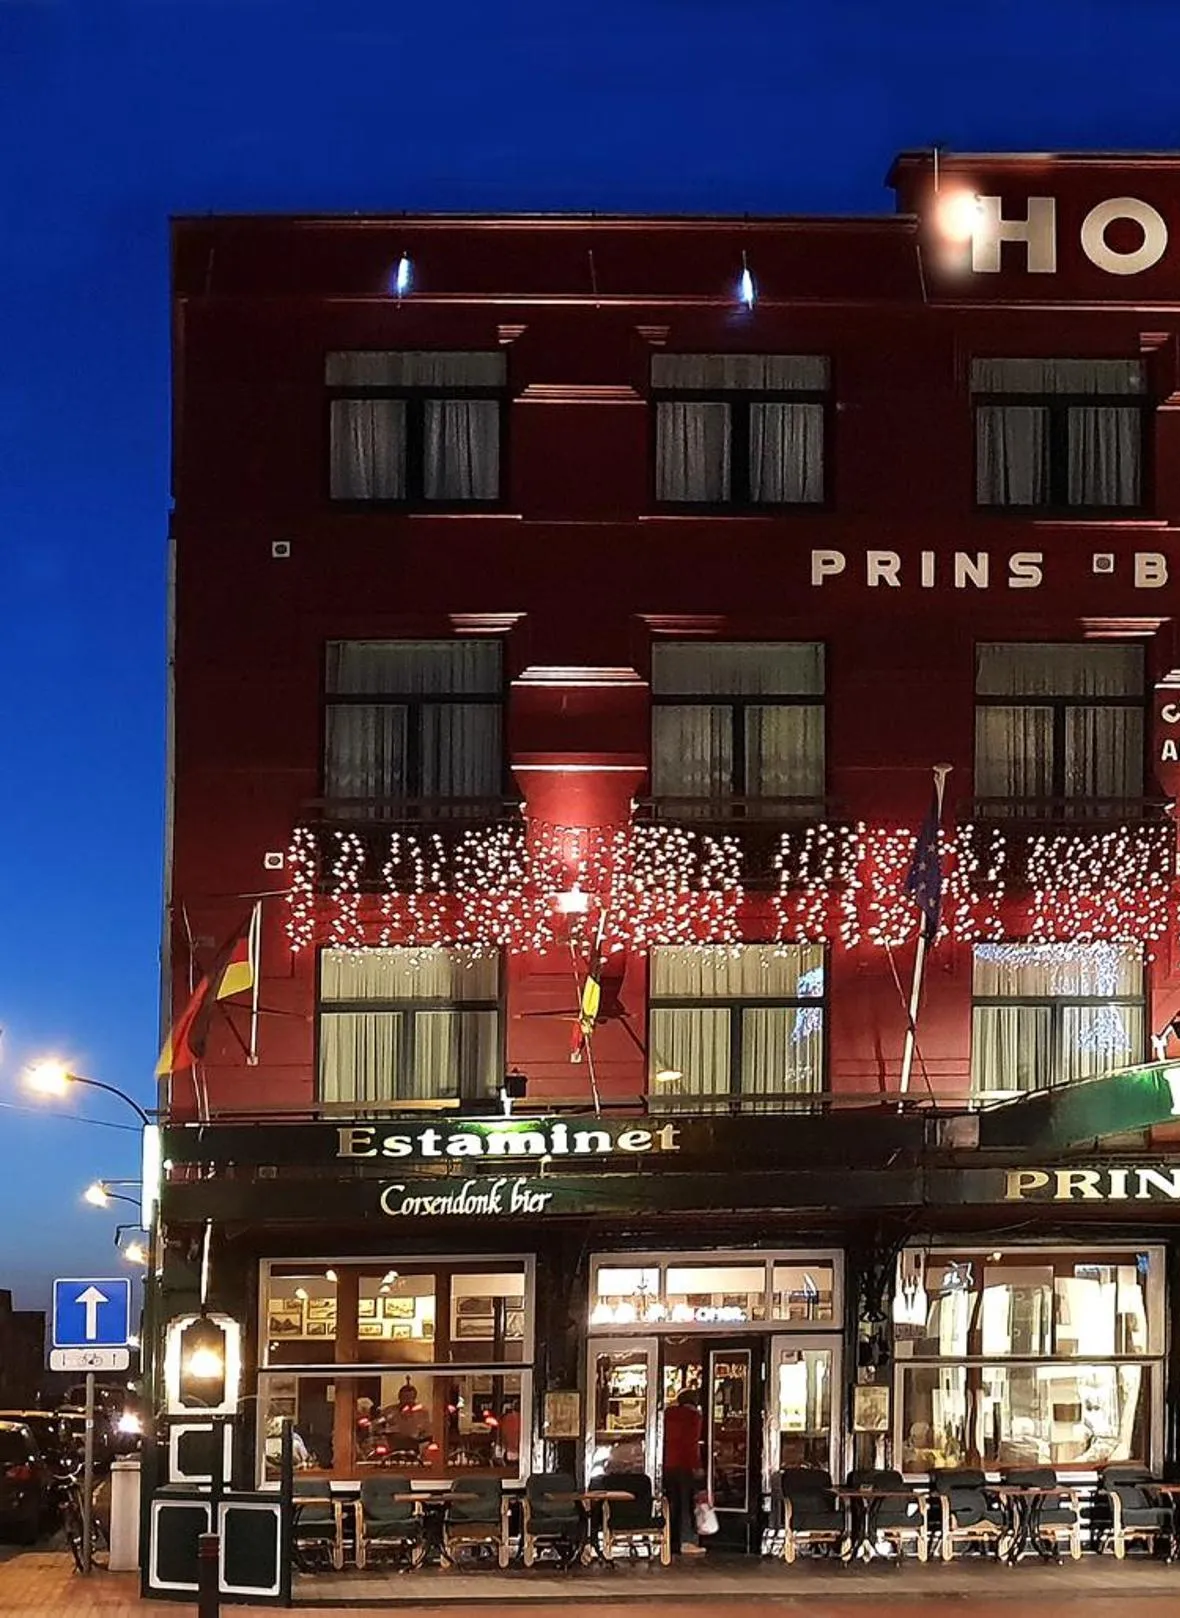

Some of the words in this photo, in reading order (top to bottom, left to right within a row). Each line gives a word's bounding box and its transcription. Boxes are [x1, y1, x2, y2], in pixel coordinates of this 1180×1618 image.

[811, 549, 1043, 589] PRINS
[336, 1123, 681, 1158] Estaminet
[380, 1179, 506, 1217] Corsendonk
[511, 1177, 552, 1215] bier
